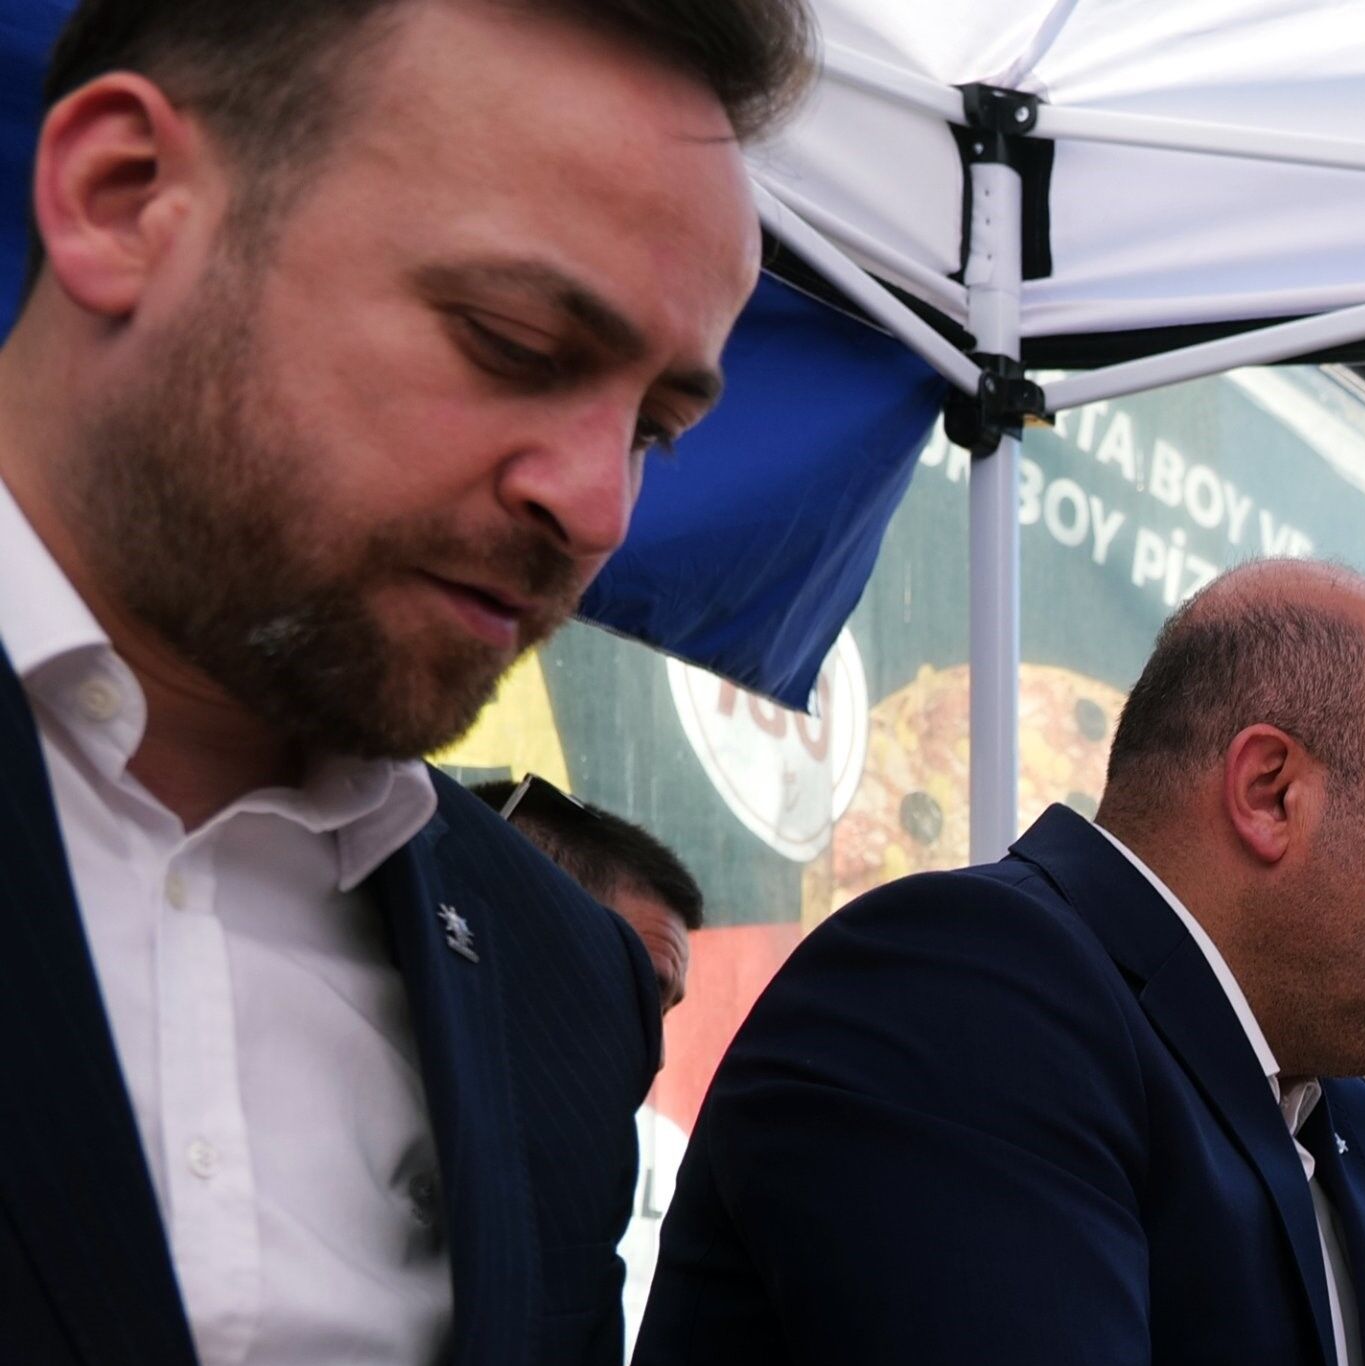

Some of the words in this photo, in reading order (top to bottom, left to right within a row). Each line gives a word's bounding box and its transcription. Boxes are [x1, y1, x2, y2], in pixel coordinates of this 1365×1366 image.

[1018, 456, 1126, 565] BOY
[1131, 525, 1220, 607] PİZ
[1149, 437, 1253, 544] BOY
